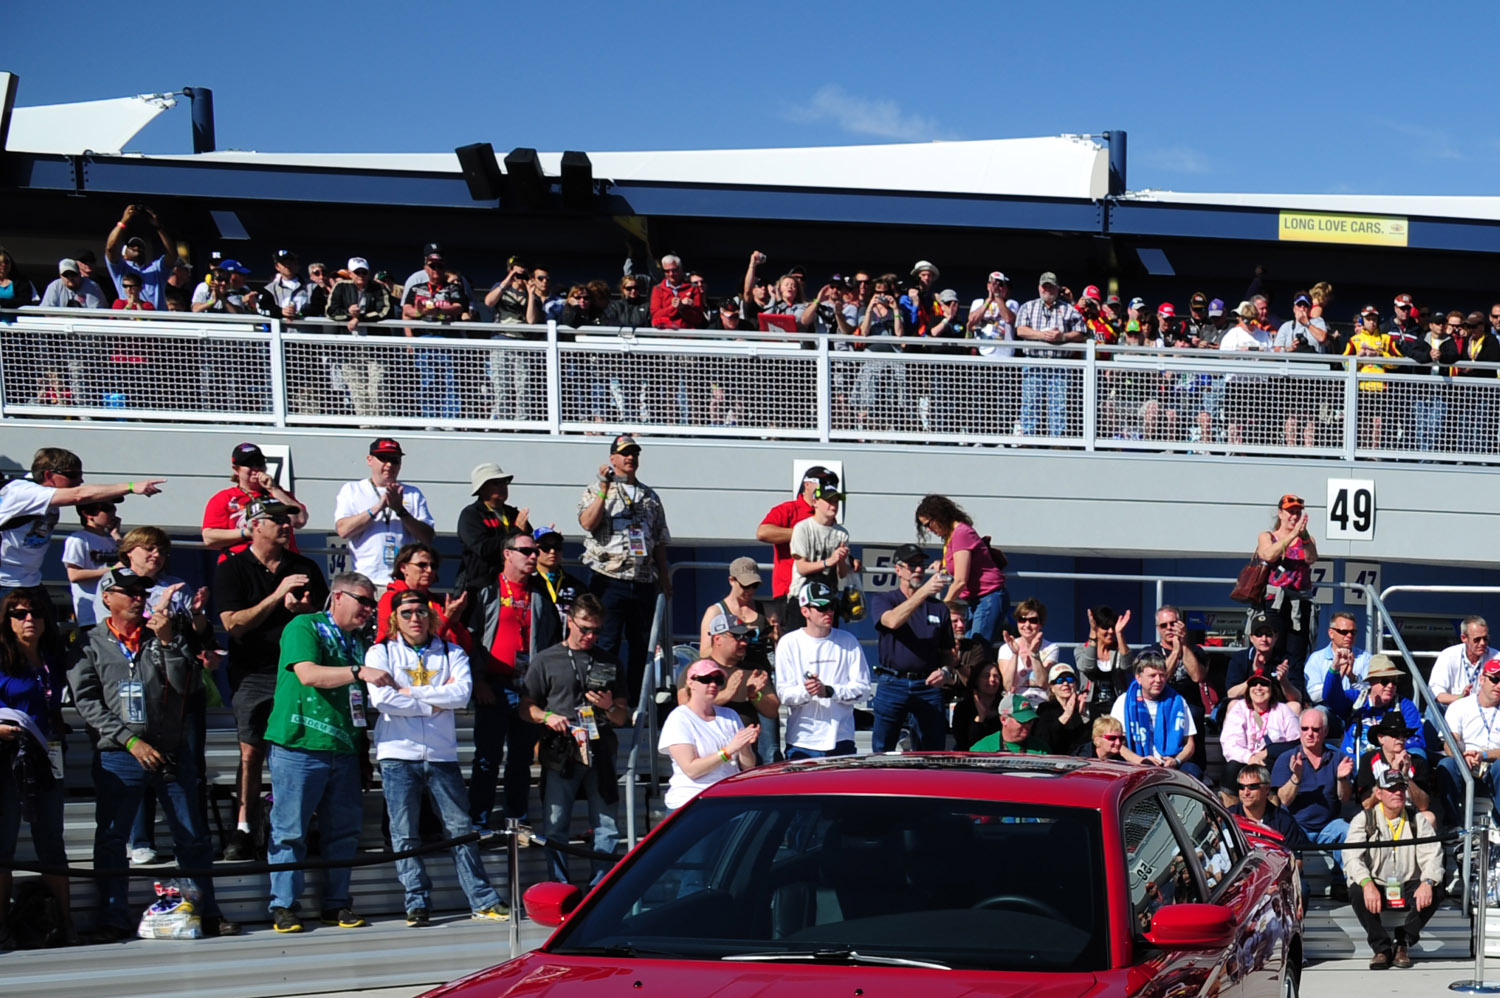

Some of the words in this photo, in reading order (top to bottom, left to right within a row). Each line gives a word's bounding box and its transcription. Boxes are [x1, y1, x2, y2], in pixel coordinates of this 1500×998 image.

[1284, 217, 1315, 231] LONG
[1318, 219, 1347, 232] LOVE
[1350, 220, 1384, 234] CARS.
[1330, 488, 1372, 532] 49
